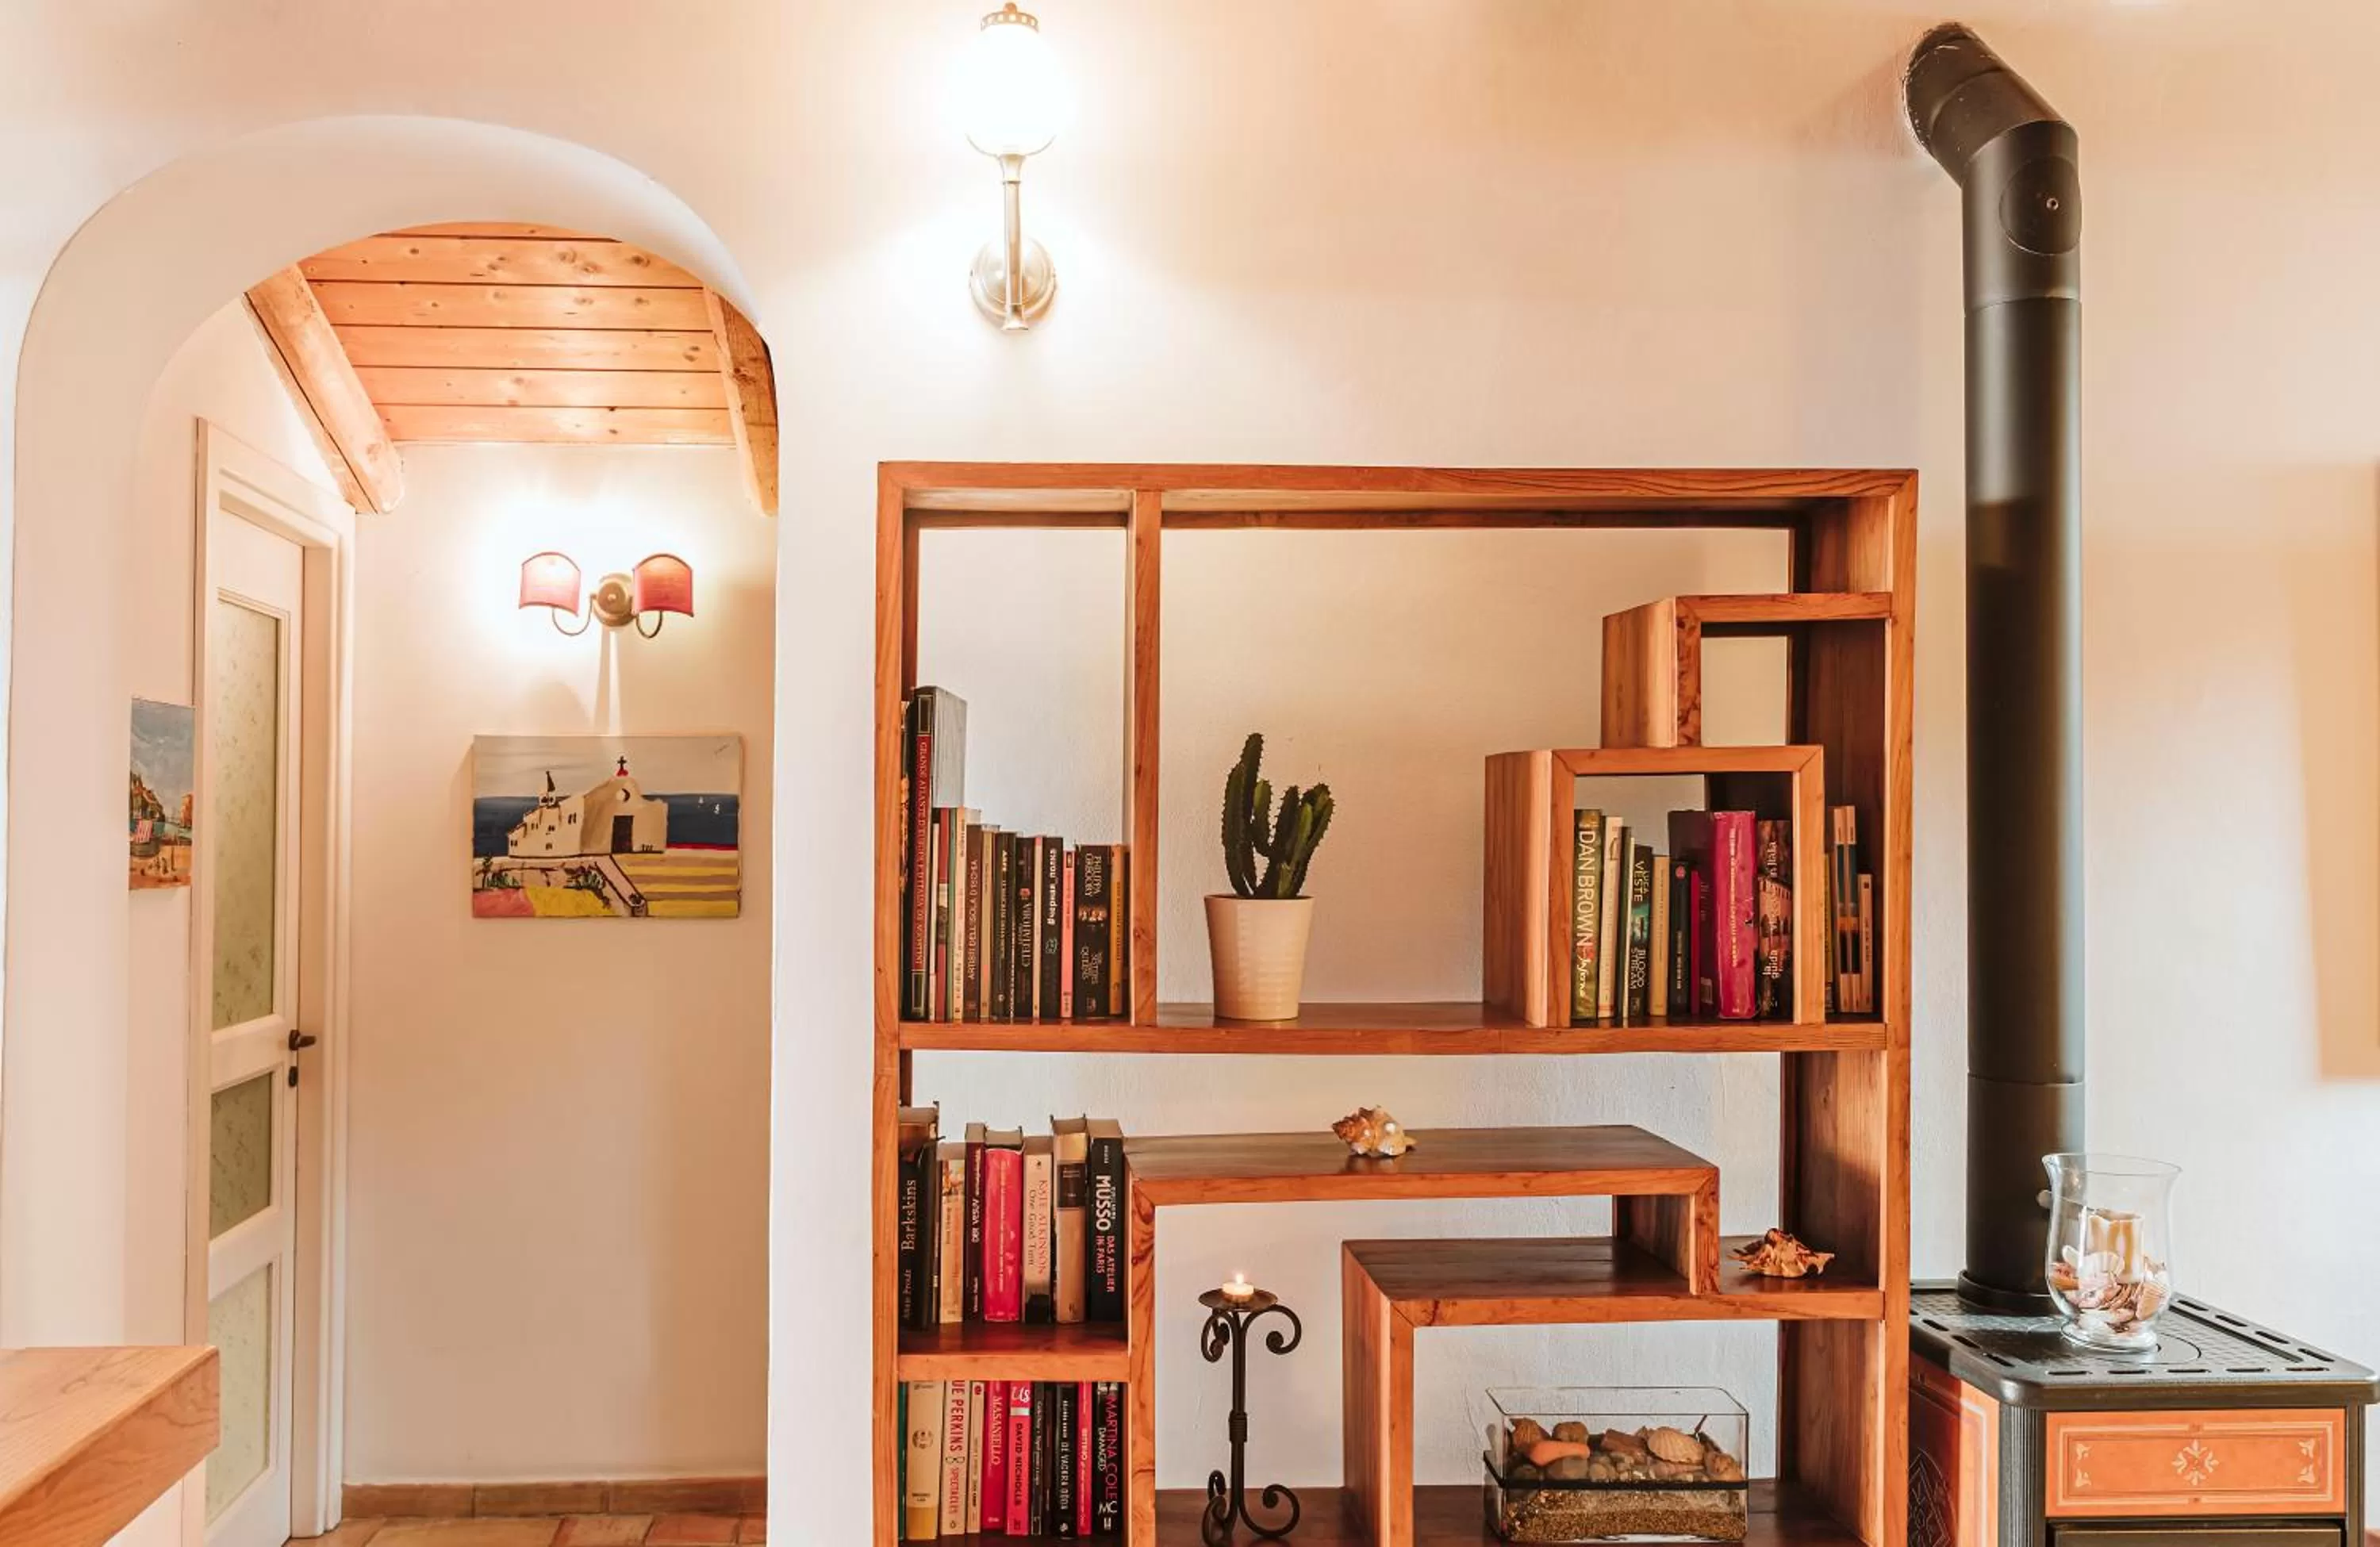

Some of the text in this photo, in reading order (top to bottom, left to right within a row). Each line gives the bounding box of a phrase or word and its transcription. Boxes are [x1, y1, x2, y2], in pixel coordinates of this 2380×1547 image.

[919, 743, 927, 777] GRANDE
[1093, 856, 1102, 894] PHILIPPA
[1577, 831, 1595, 946] DAN BROWN
[1633, 860, 1645, 902] VESTE
[1637, 950, 1646, 988] BLOOD
[1762, 965, 1771, 975] la
[1768, 950, 1781, 979] guida
[901, 1180, 916, 1250] Barkskins
[1096, 1175, 1111, 1231] MUSSO
[1038, 1214, 1048, 1275] ATKINSON
[1096, 1235, 1105, 1274] IN PARIS
[950, 1380, 965, 1453] UE PERKINS
[1012, 1387, 1031, 1403] Us
[992, 1396, 1004, 1465] MASANIELLO
[1098, 1427, 1107, 1472] DAMAGED
[1105, 1395, 1118, 1499] MARTINA COLE
[949, 1468, 960, 1515] SPECTACLES
